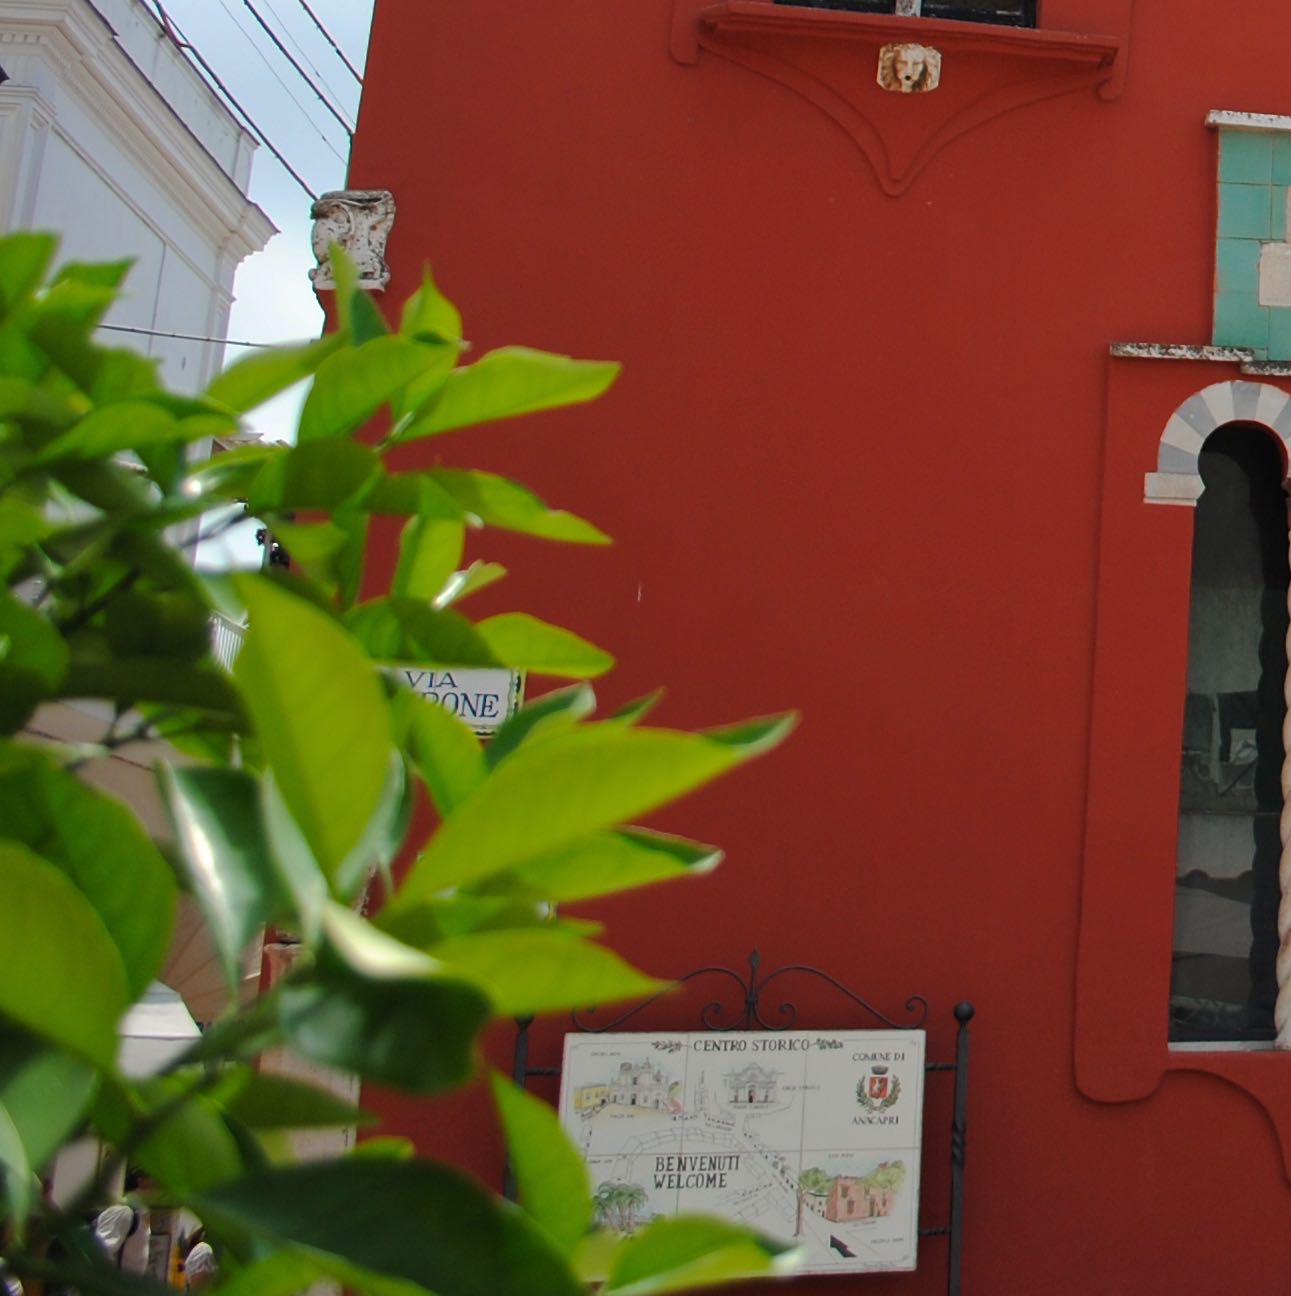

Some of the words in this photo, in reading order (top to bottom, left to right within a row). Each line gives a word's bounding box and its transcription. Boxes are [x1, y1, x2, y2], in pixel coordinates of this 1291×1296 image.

[405, 670, 458, 688] VIA
[693, 1039, 747, 1052] CENTRO
[751, 1038, 810, 1051] STORICO
[852, 1052, 891, 1061] COMUNE
[893, 1052, 905, 1061] DI
[852, 1115, 899, 1125] ANACAPRI
[655, 1155, 740, 1172] BENVENUTI
[653, 1173, 728, 1190] WELCOME
